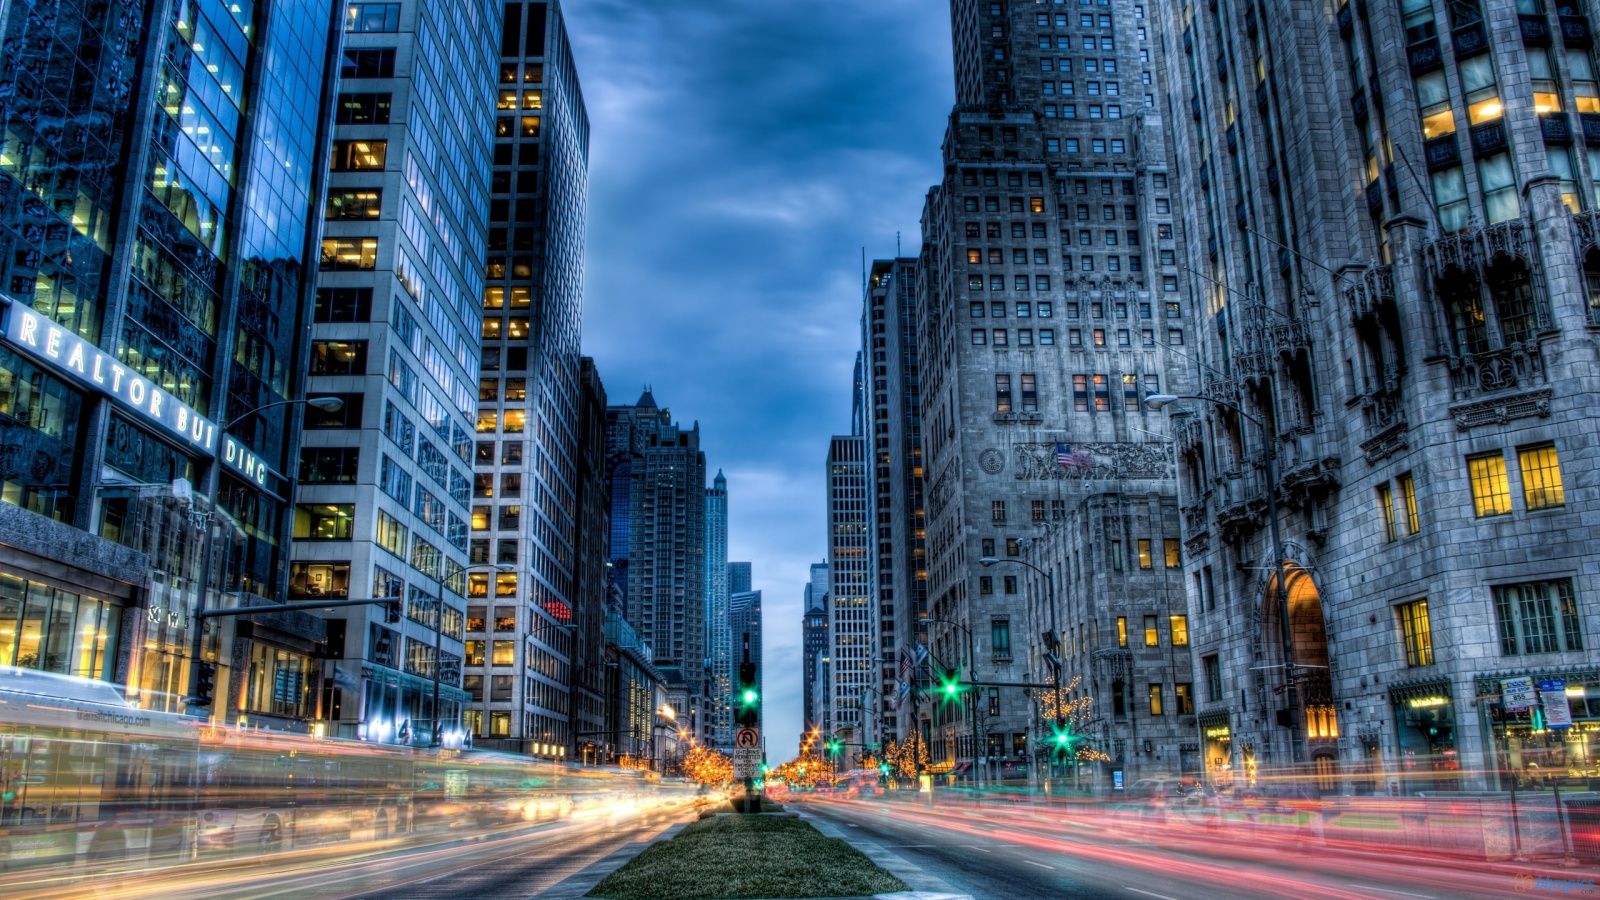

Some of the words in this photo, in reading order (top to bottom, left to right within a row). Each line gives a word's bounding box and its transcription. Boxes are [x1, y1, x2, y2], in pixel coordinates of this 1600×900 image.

[20, 311, 162, 418] REALTOR
[177, 406, 265, 485] BUIDING
[77, 707, 151, 728] transitchicago.com
